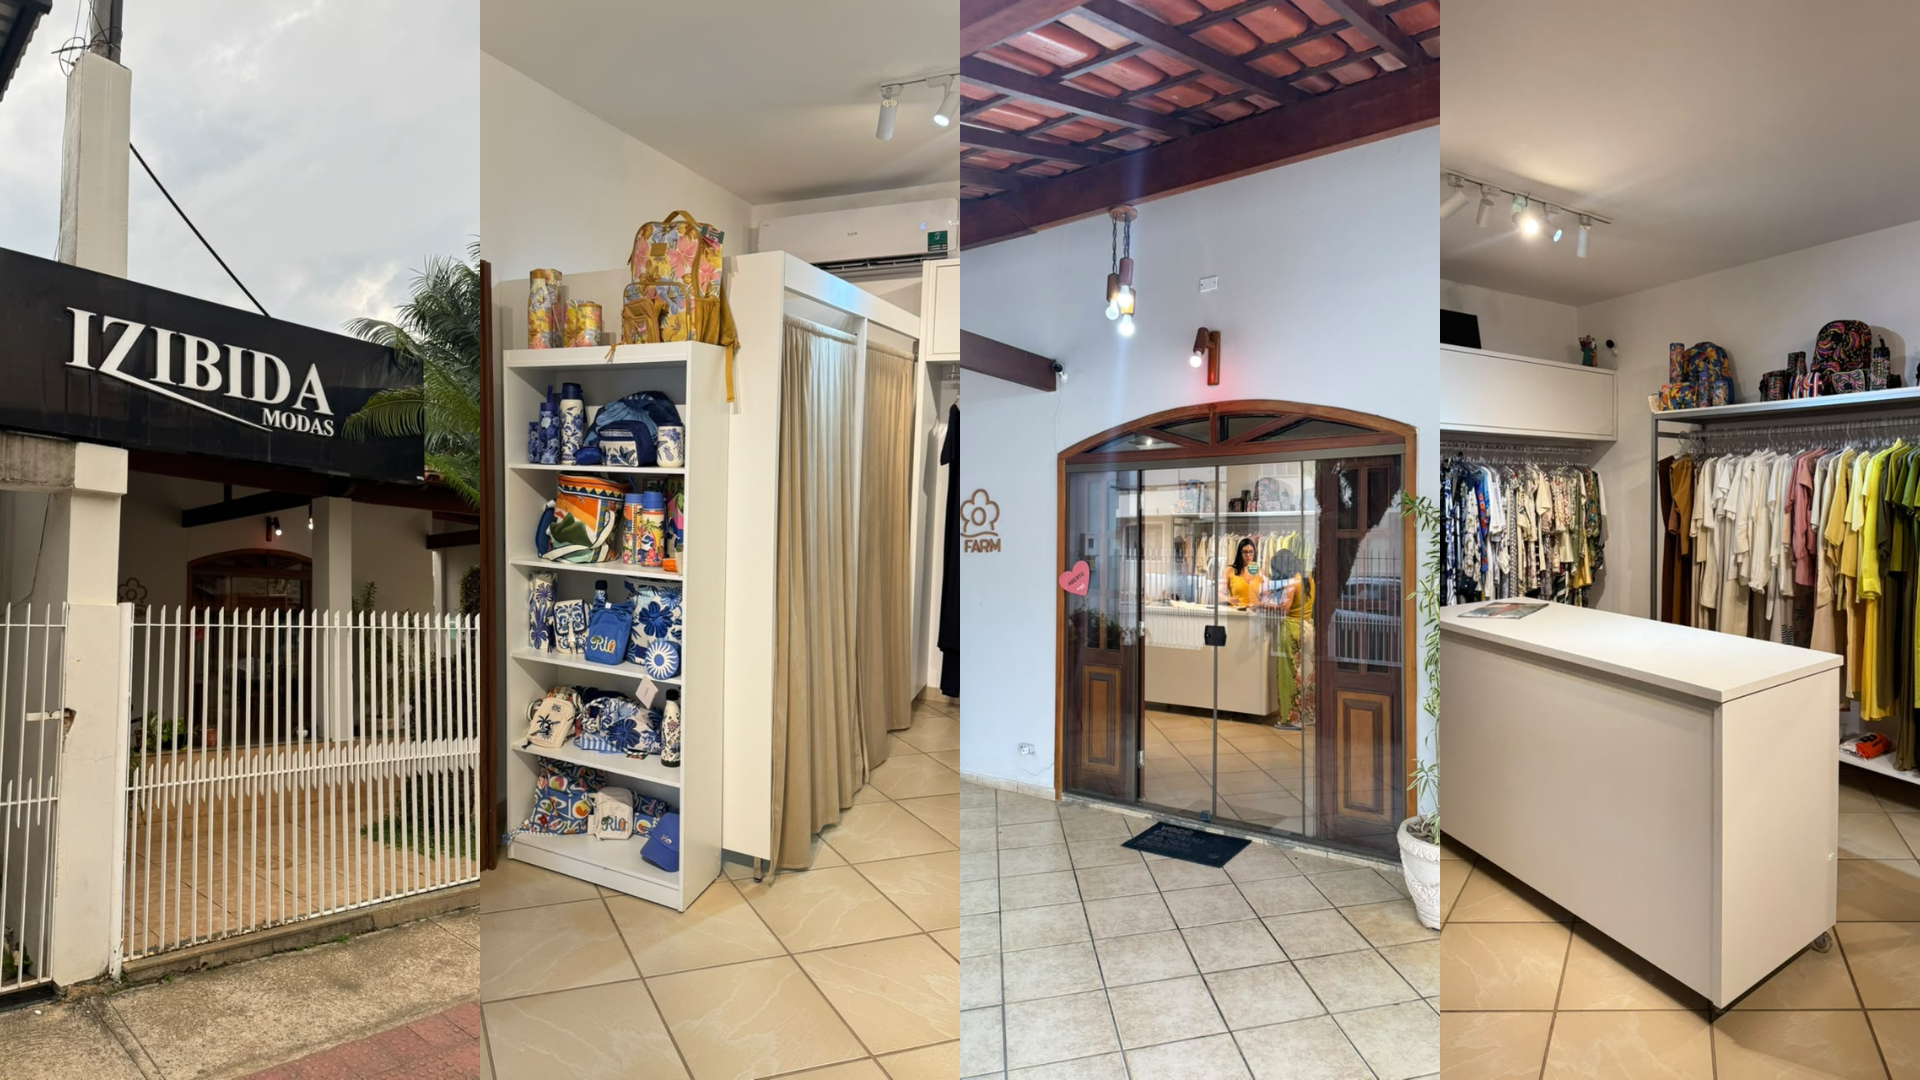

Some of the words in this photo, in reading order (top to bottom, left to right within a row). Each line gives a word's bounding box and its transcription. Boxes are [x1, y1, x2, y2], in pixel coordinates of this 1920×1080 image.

[65, 306, 334, 416] IZIBIDA
[261, 407, 334, 437] MODAS
[964, 537, 1001, 553] FARM
[1067, 571, 1085, 586] ABERTO
